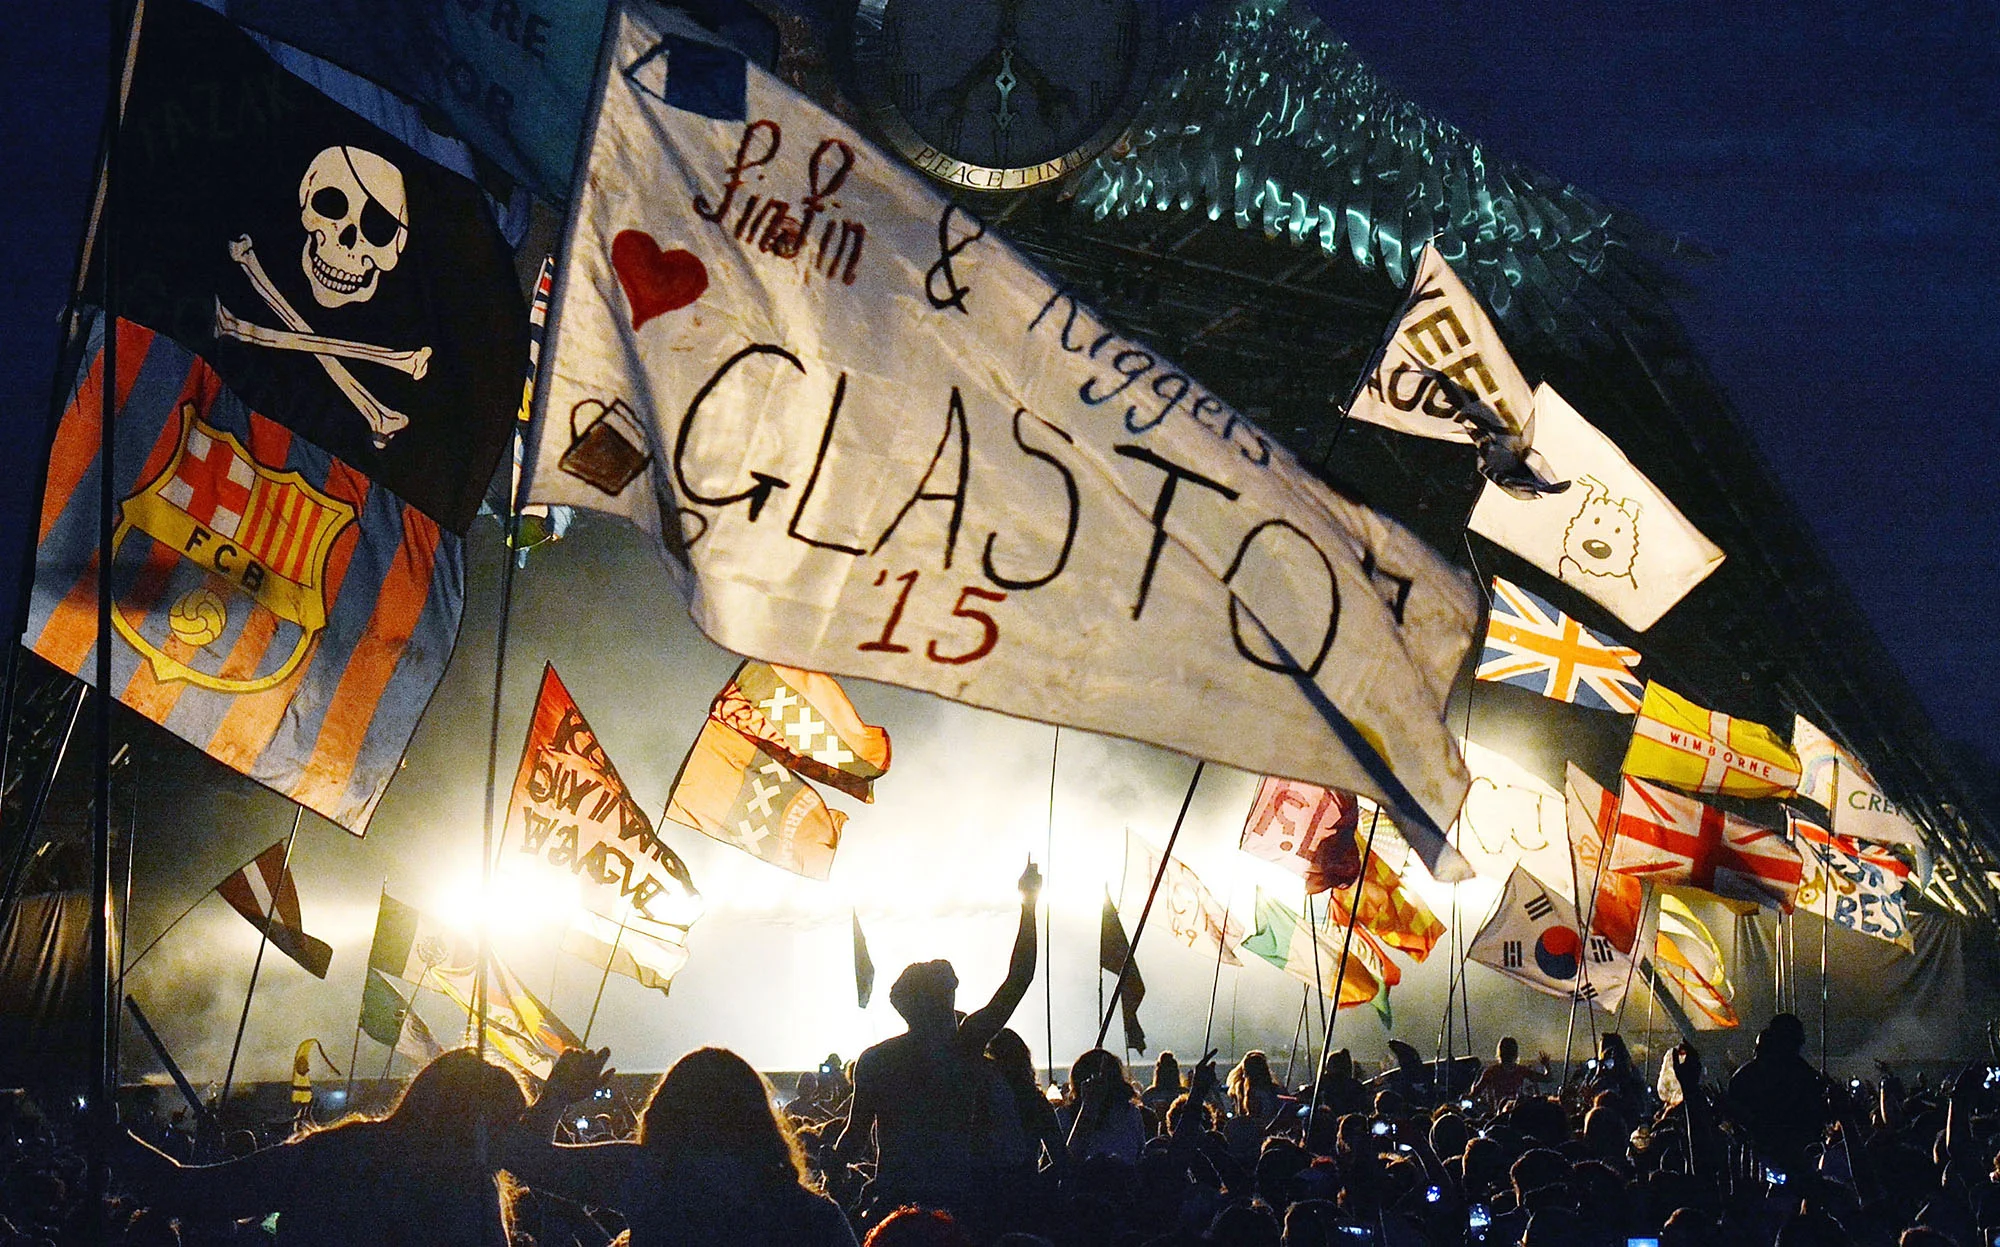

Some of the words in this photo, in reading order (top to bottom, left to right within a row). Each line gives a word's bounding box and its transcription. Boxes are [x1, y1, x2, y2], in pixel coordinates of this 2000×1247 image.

[913, 145, 1004, 188] PEACE
[925, 204, 986, 315] &
[674, 343, 1341, 677] GLASTO
[857, 568, 1007, 665] '15
[1670, 731, 1772, 778] WIMBORNE
